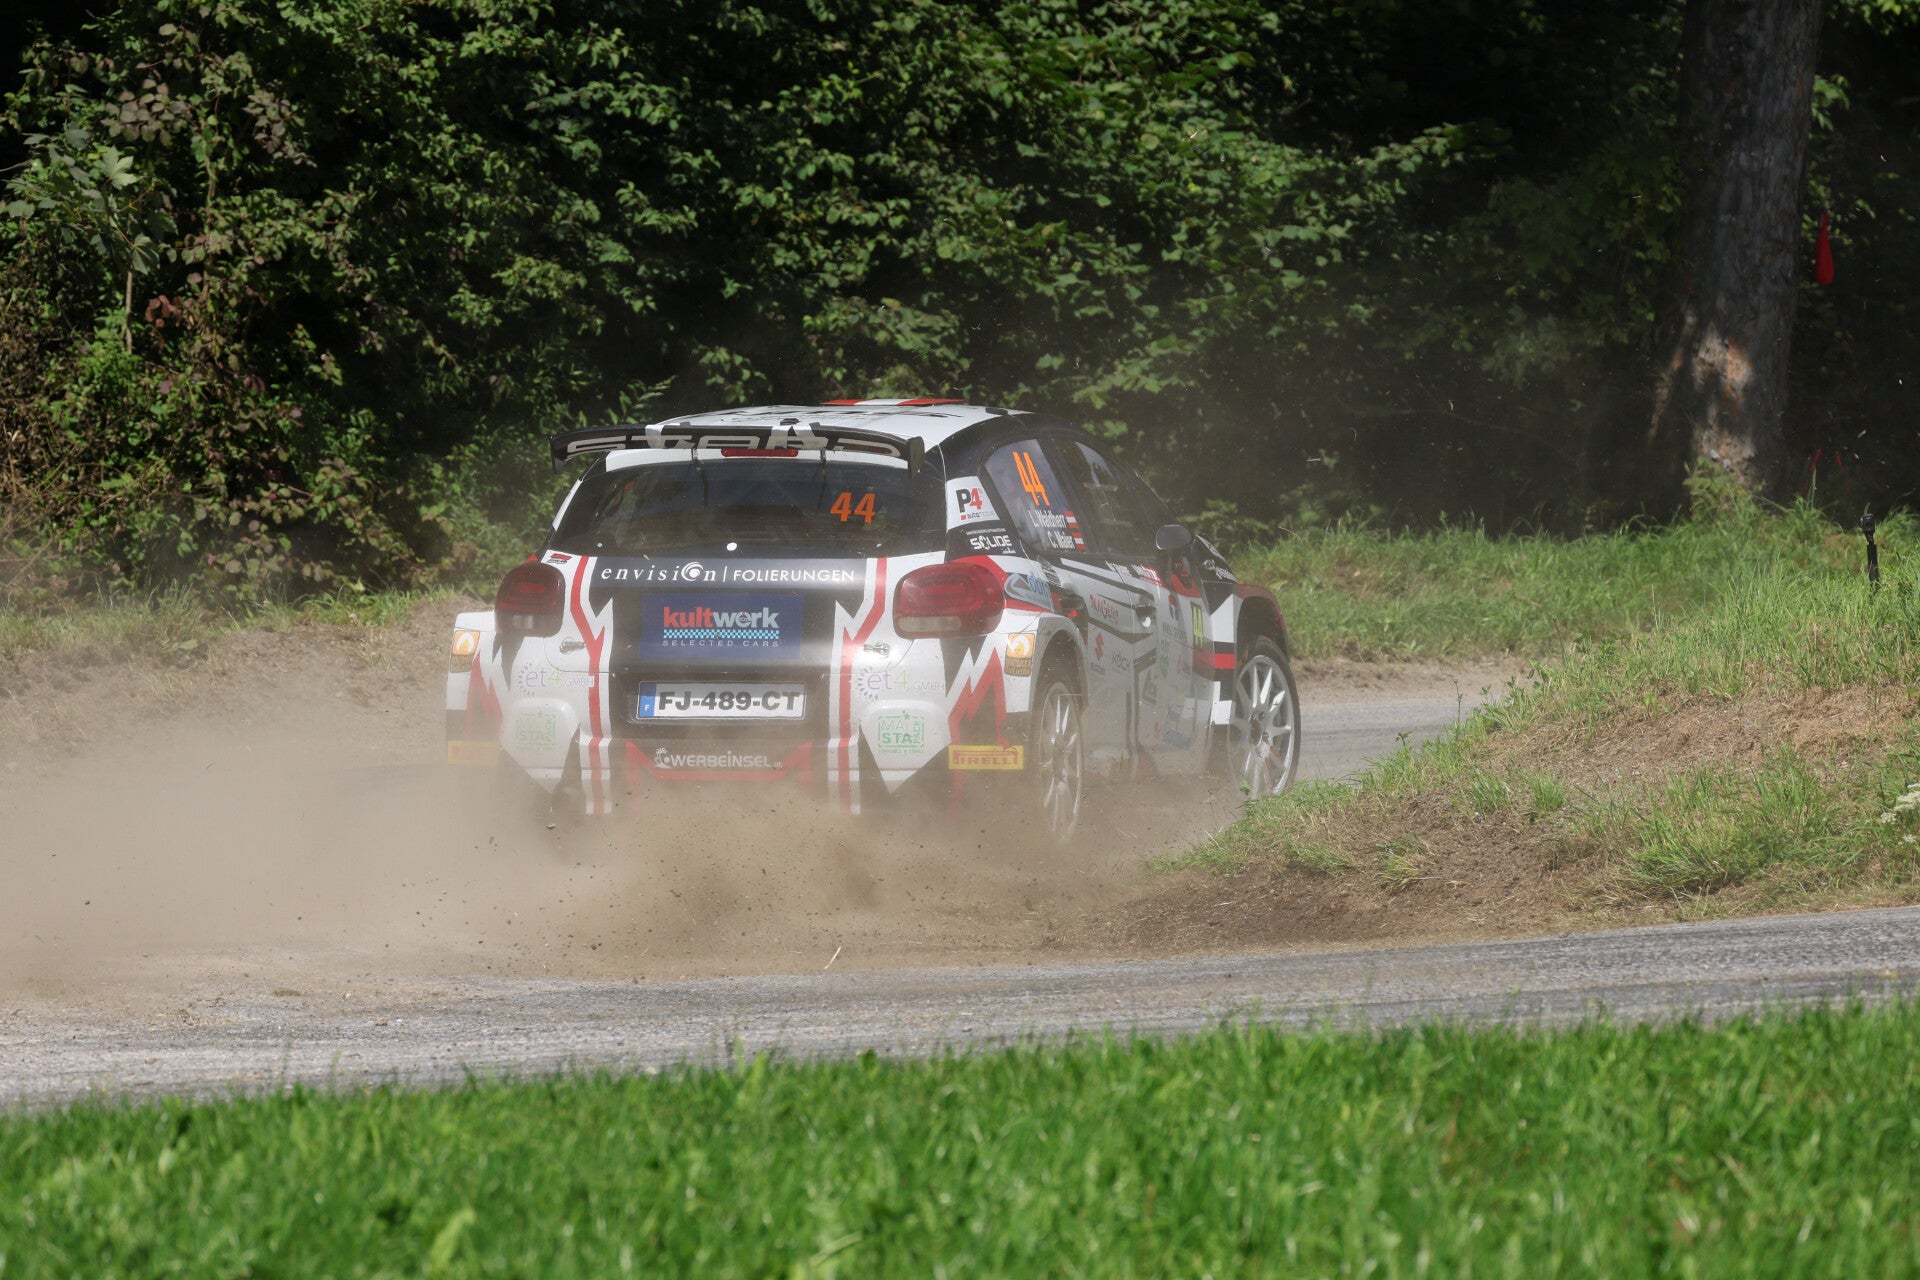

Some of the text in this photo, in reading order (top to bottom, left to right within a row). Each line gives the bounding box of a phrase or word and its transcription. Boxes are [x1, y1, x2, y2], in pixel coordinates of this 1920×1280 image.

[1012, 451, 1050, 506] 44
[830, 492, 876, 523] 44
[956, 487, 983, 513] P4
[733, 569, 855, 582] FOLIERUNGEN
[663, 606, 779, 628] kultwerk
[658, 691, 801, 711] FJ-489-CT
[882, 732, 913, 744] STA
[952, 749, 1019, 765] PIRELLI
